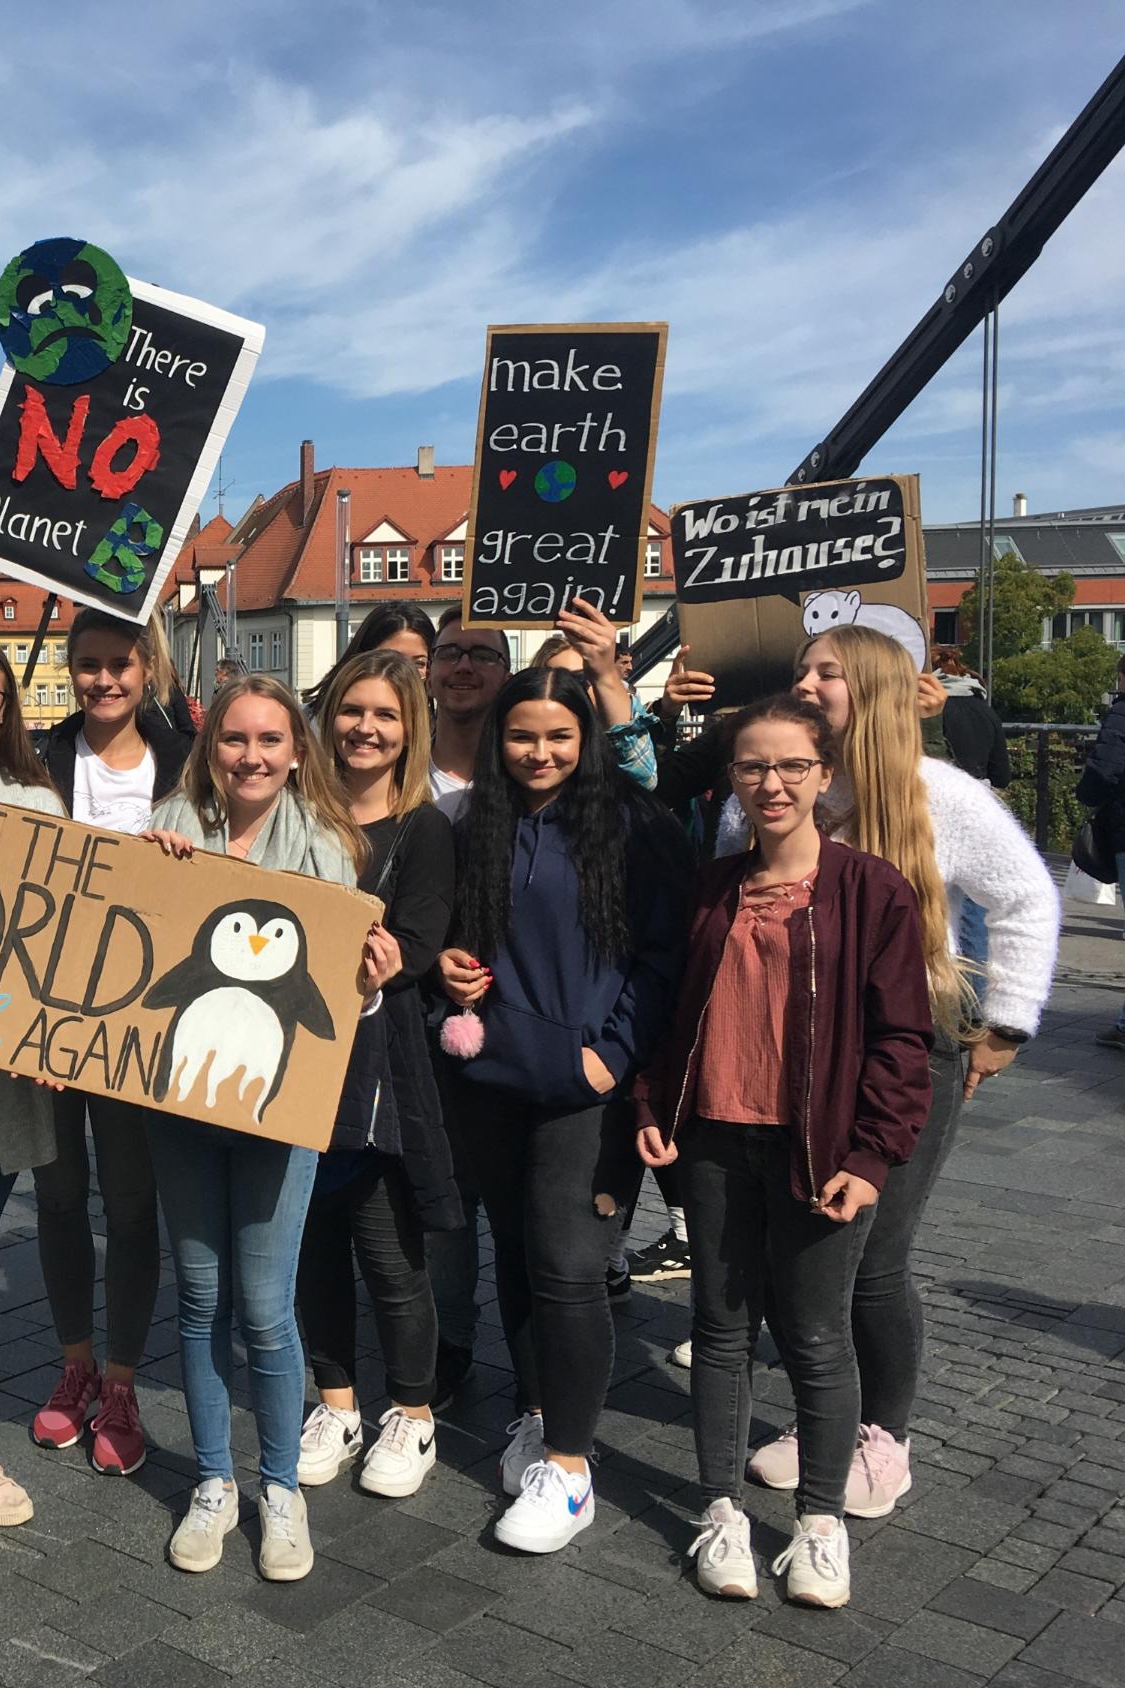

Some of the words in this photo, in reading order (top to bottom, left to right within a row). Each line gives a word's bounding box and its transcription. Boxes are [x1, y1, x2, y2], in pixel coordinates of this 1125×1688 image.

[125, 325, 207, 388] There
[489, 349, 623, 392] make
[122, 377, 151, 411] is
[11, 384, 161, 500] NO
[489, 412, 627, 454] earth
[478, 525, 620, 565] great
[681, 503, 739, 543] Wo
[745, 493, 792, 530] ist
[83, 502, 164, 594] B
[683, 516, 905, 588] Zuhause?
[472, 575, 626, 615] again!
[22, 815, 121, 901] THE
[9, 1007, 162, 1096] AGAIN
